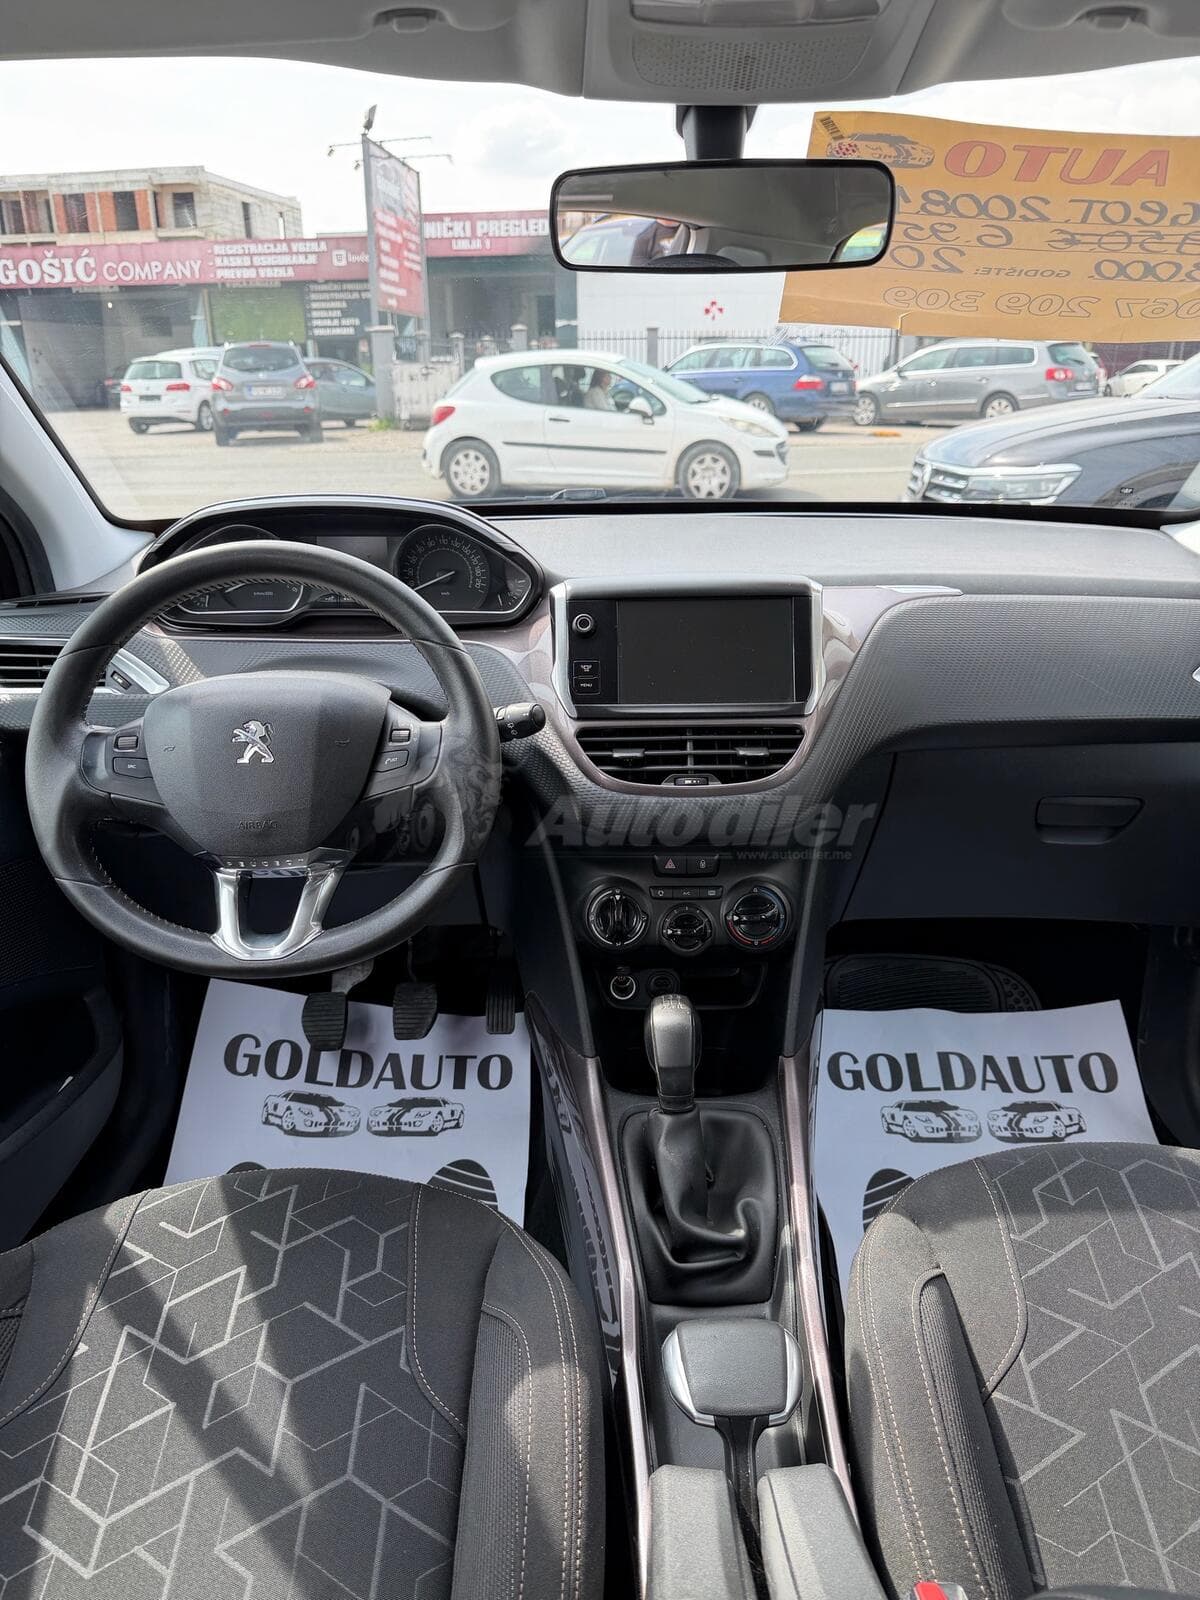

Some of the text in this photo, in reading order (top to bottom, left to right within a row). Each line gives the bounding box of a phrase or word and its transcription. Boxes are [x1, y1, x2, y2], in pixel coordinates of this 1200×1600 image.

[476, 217, 549, 237] PREGLED
[0, 249, 202, 285] GOŠIĆ COMPANY
[239, 820, 279, 831] AIRBAG
[223, 1033, 513, 1091] GOLDAUTO
[826, 1050, 1119, 1094] GOLDAUTO
